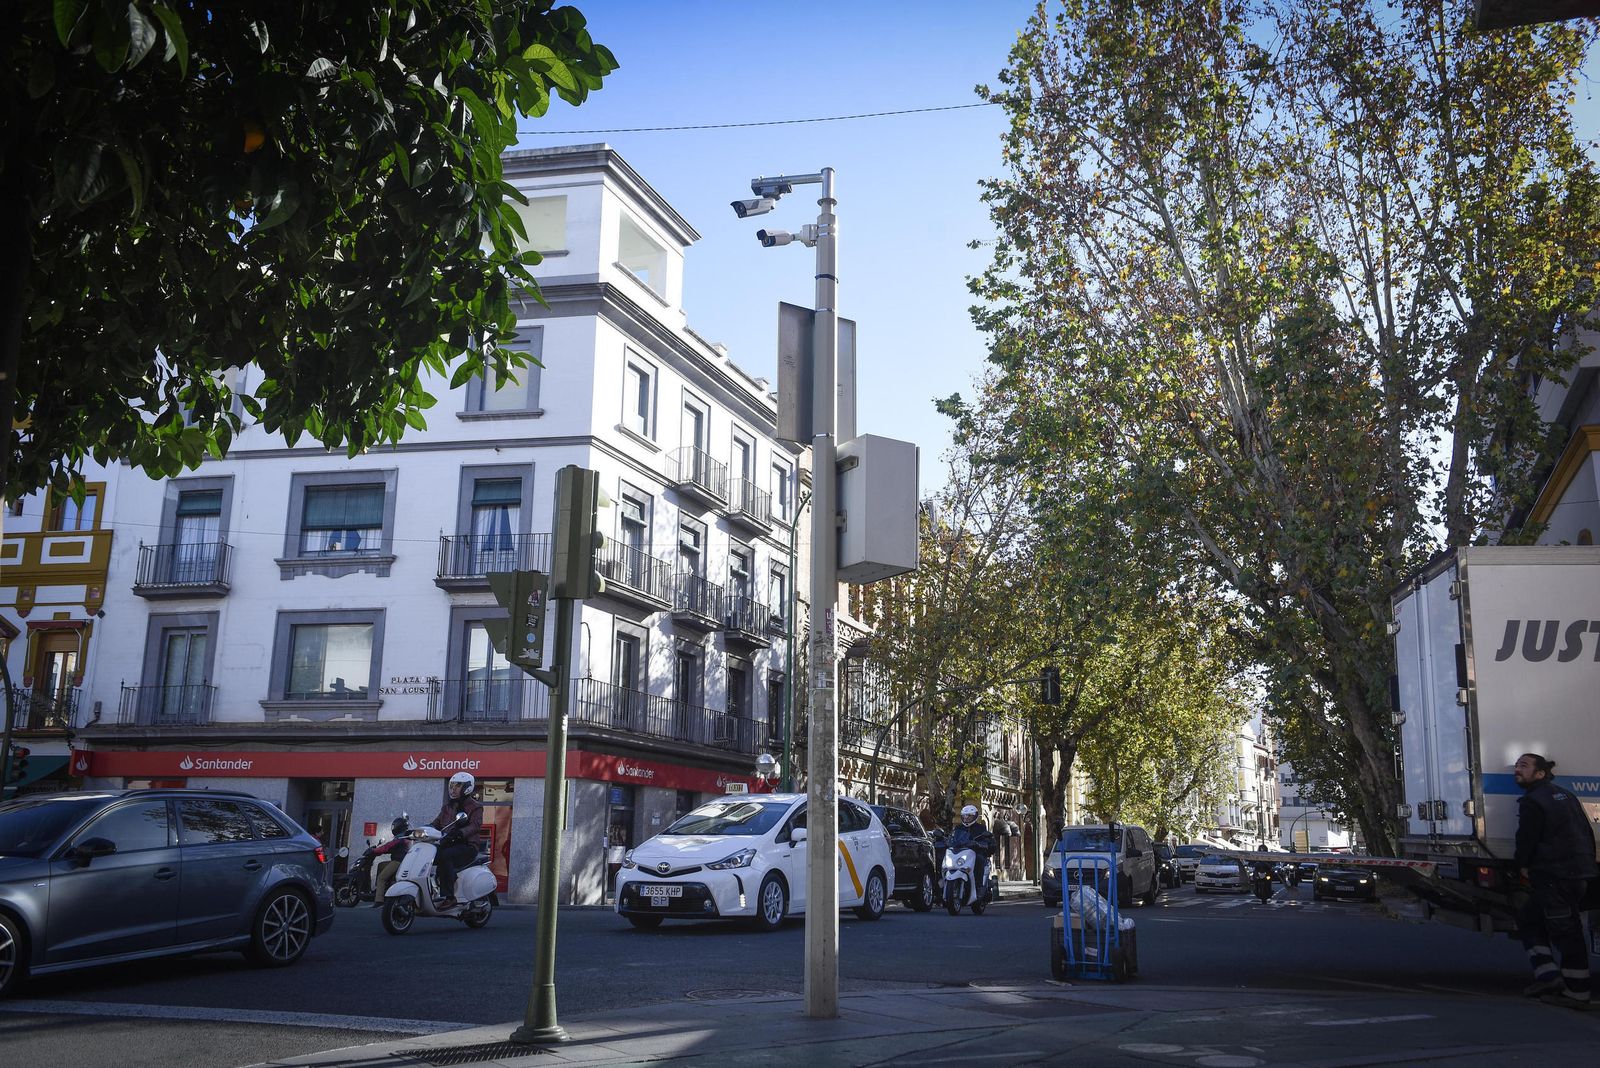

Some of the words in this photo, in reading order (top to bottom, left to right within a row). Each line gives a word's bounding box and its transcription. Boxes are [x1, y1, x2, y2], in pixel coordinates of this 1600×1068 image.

[391, 676, 420, 684] PLAZA
[195, 758, 253, 770] Santander
[419, 758, 480, 770] Santander
[625, 764, 655, 779] Santander
[666, 887, 681, 896] KHP
[653, 896, 667, 905] SP
